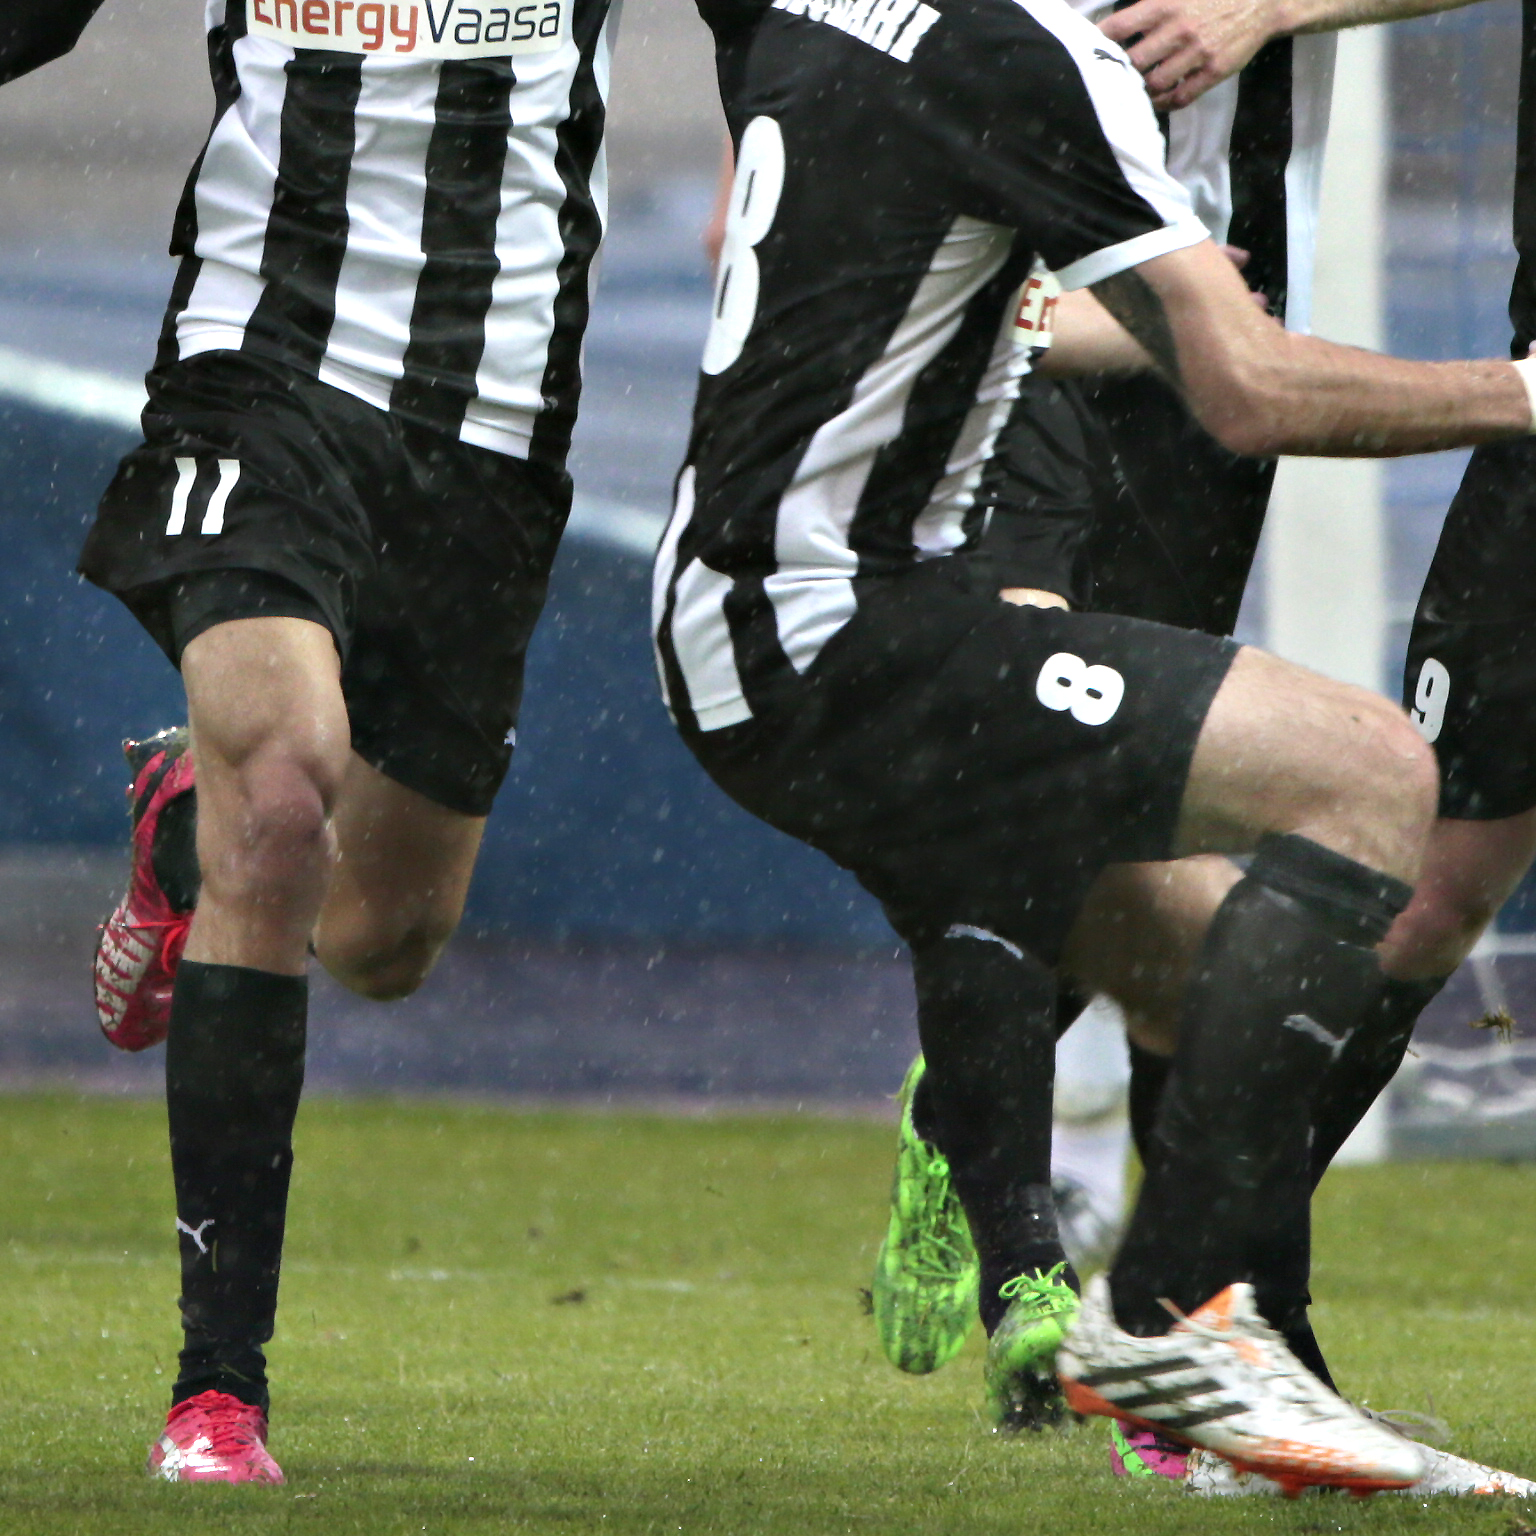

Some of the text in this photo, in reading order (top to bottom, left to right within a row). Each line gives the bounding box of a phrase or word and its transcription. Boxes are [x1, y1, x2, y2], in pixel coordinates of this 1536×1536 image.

[701, 115, 786, 376] 8
[165, 457, 241, 536] 11
[1035, 651, 1125, 727] 8
[1410, 657, 1451, 744] 9
